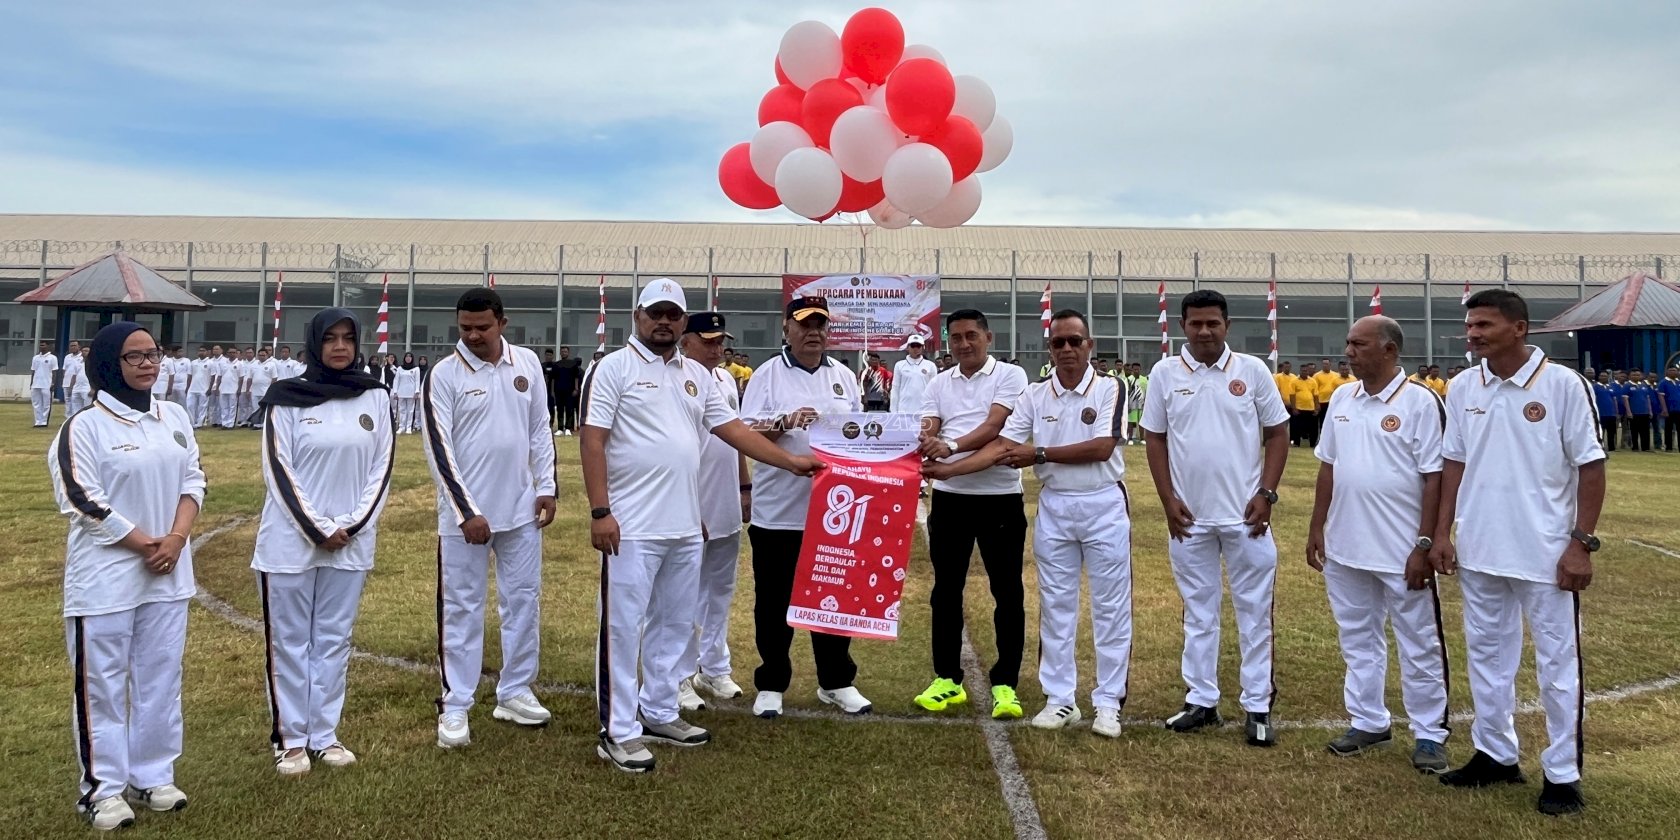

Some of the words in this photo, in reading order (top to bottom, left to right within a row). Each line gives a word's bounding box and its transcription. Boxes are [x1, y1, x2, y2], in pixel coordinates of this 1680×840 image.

[856, 289, 906, 299] PEMBUKAAN
[867, 474, 904, 487] INDONESIA
[822, 484, 874, 545] 81
[817, 544, 855, 557] INDONESIA
[815, 554, 857, 567] BERDAULAT
[813, 564, 829, 574] ADIL
[830, 566, 846, 576] DAN
[811, 573, 845, 585] MAKMUR
[794, 609, 816, 621] LAPAS
[816, 612, 838, 625] KELAS
[849, 617, 872, 629] BANDA
[872, 620, 891, 632] ACEH
